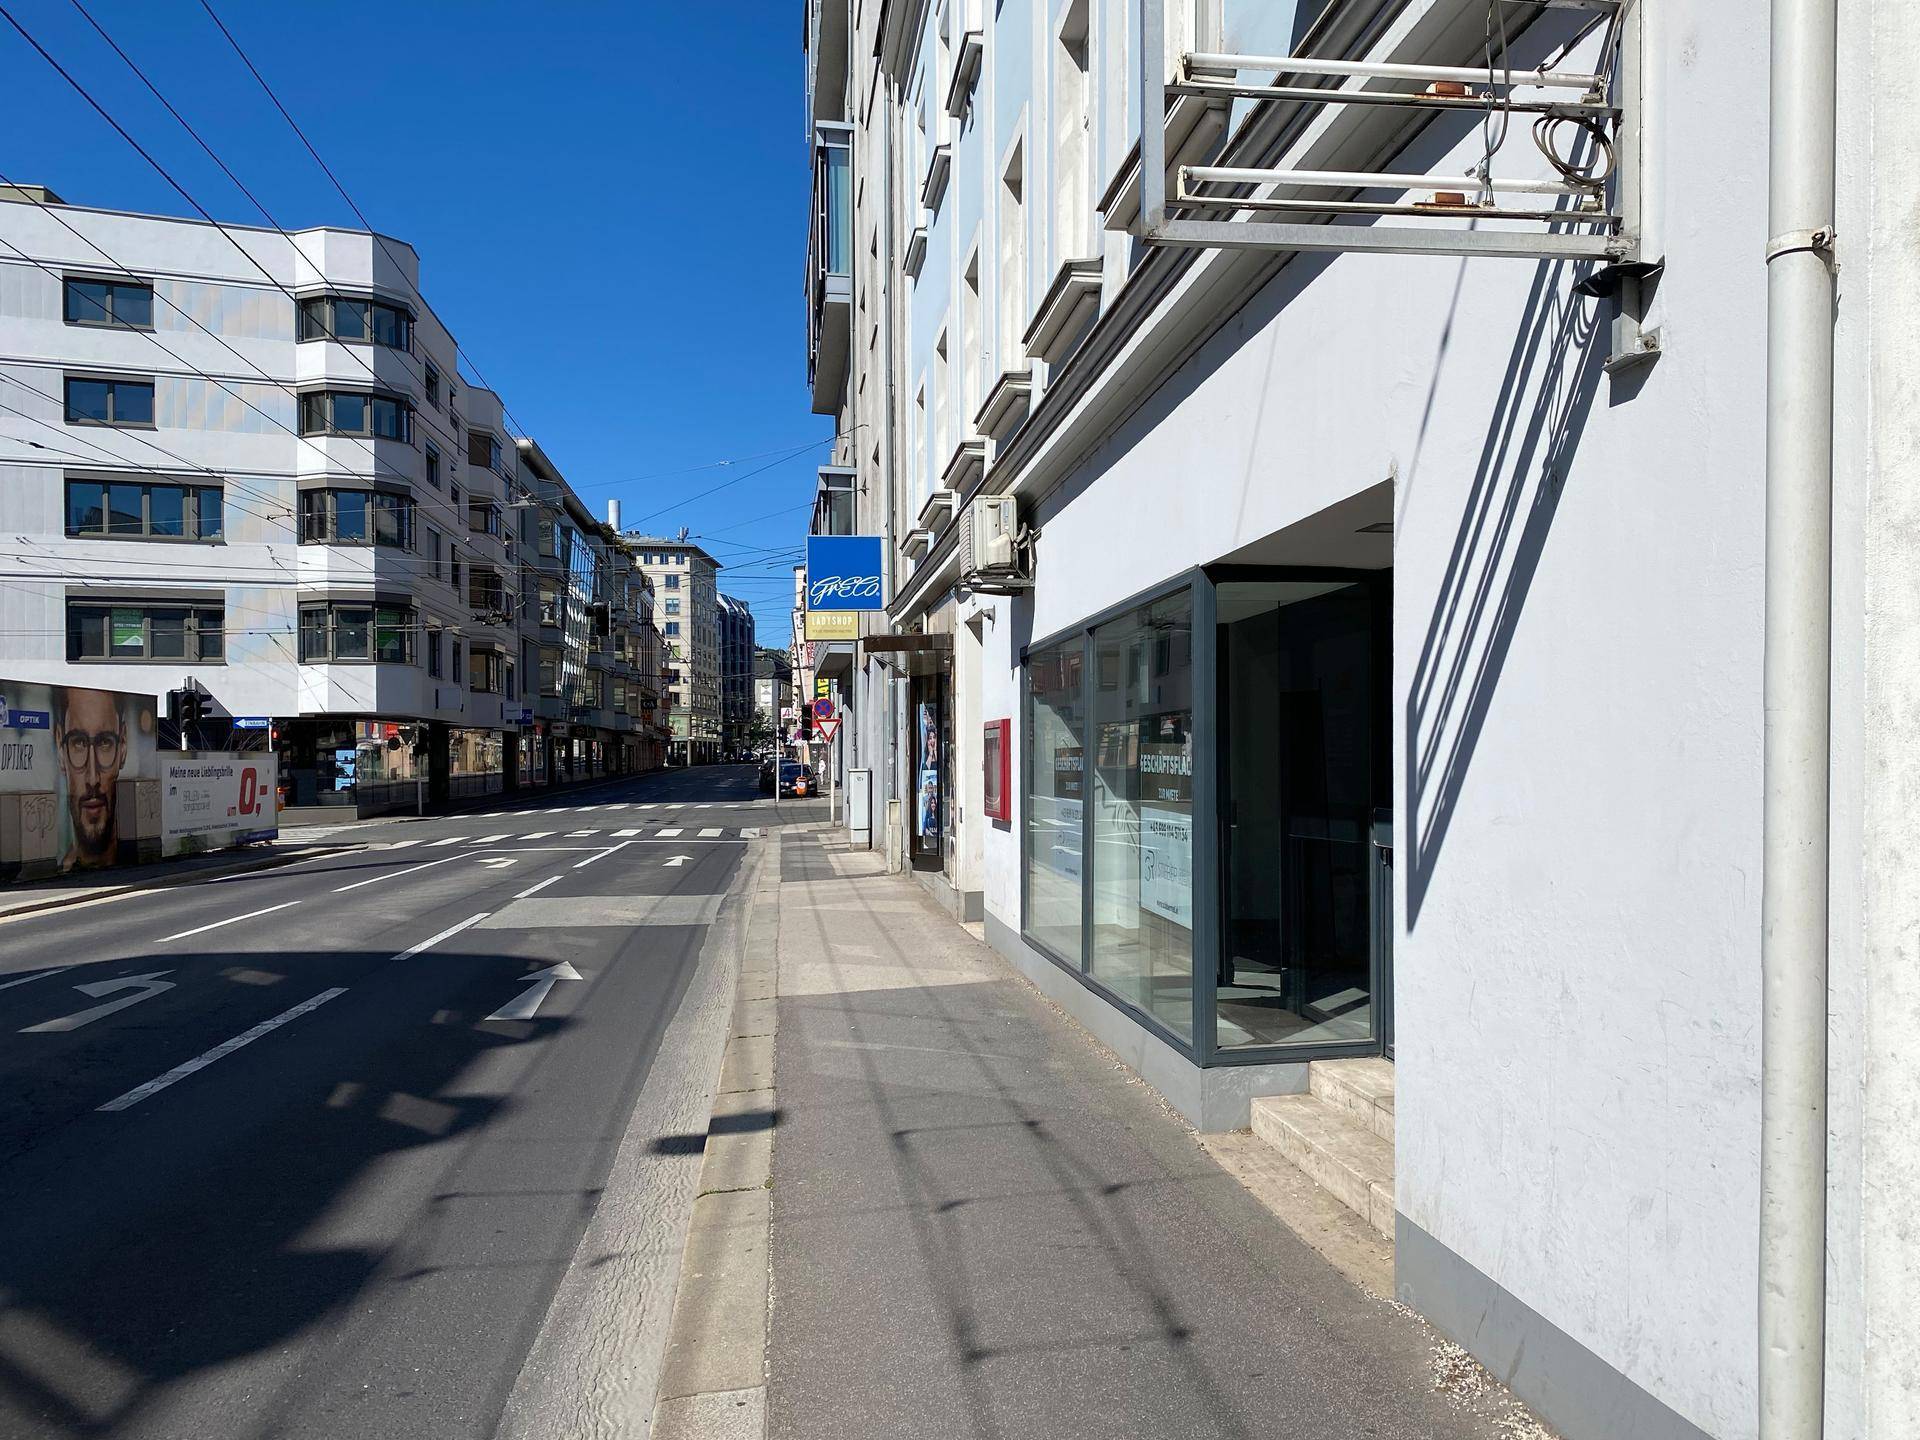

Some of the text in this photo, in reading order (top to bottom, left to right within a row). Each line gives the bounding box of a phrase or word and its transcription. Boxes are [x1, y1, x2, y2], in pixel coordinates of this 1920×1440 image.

[811, 616, 853, 626] LADYSHOP
[19, 715, 40, 724] OPTIK
[1, 744, 34, 770] OPTIKER
[169, 766, 186, 779] Meine
[187, 768, 201, 778] neue
